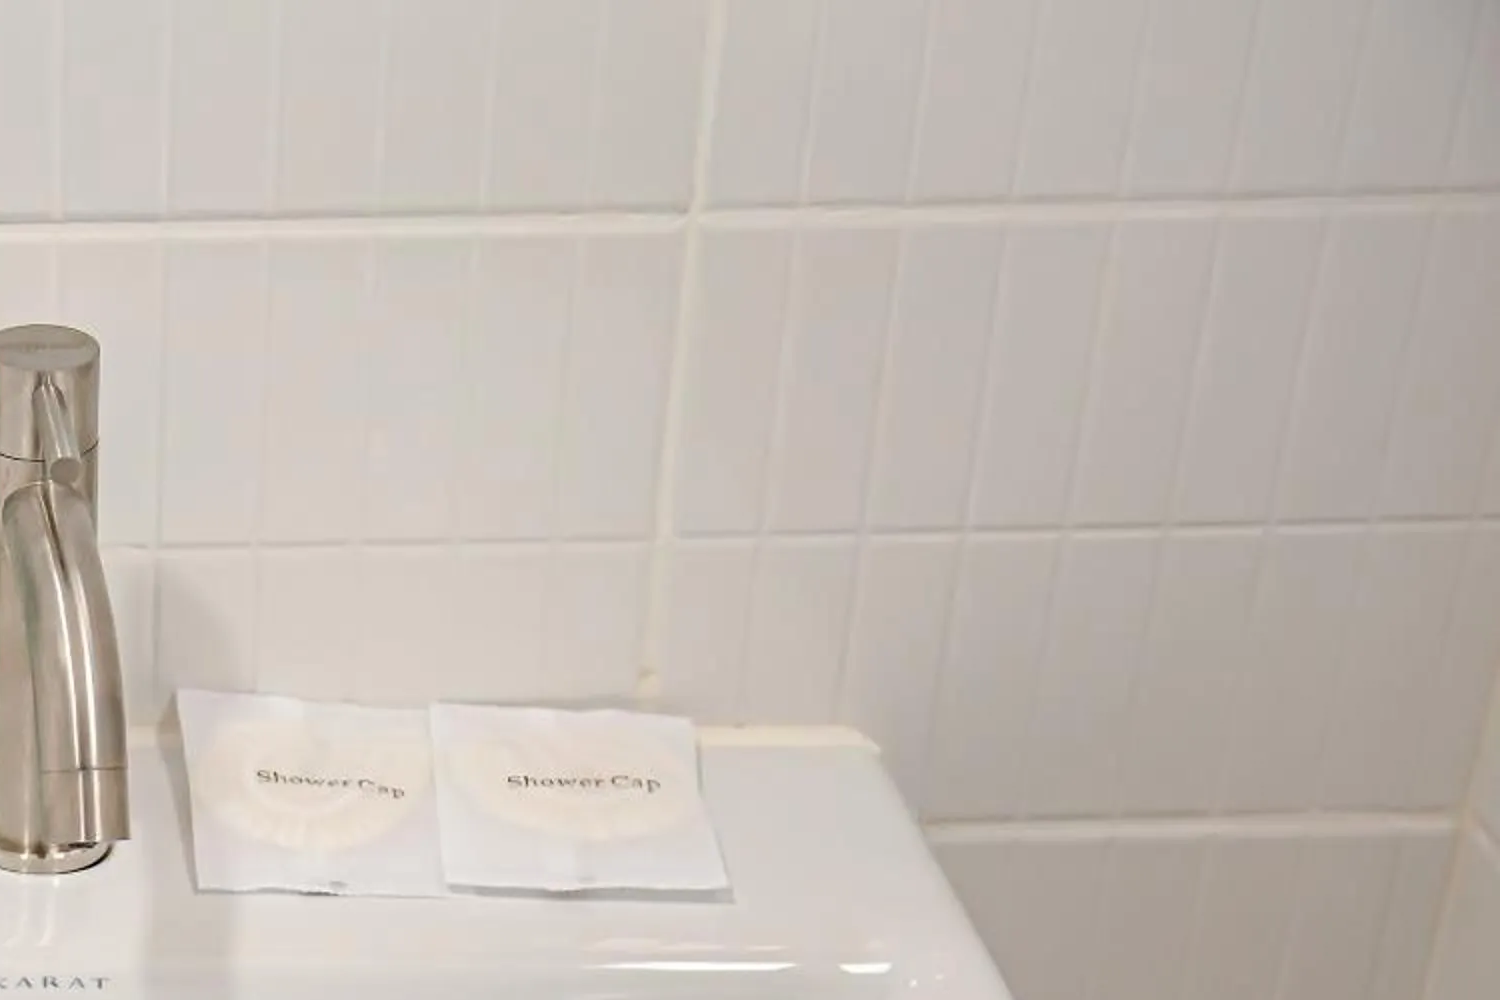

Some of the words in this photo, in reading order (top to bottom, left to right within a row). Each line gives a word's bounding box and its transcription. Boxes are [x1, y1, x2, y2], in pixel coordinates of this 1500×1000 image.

[256, 769, 350, 787] Shower
[357, 779, 405, 799] Cap
[507, 774, 604, 790] Shower
[610, 774, 661, 792] Cap
